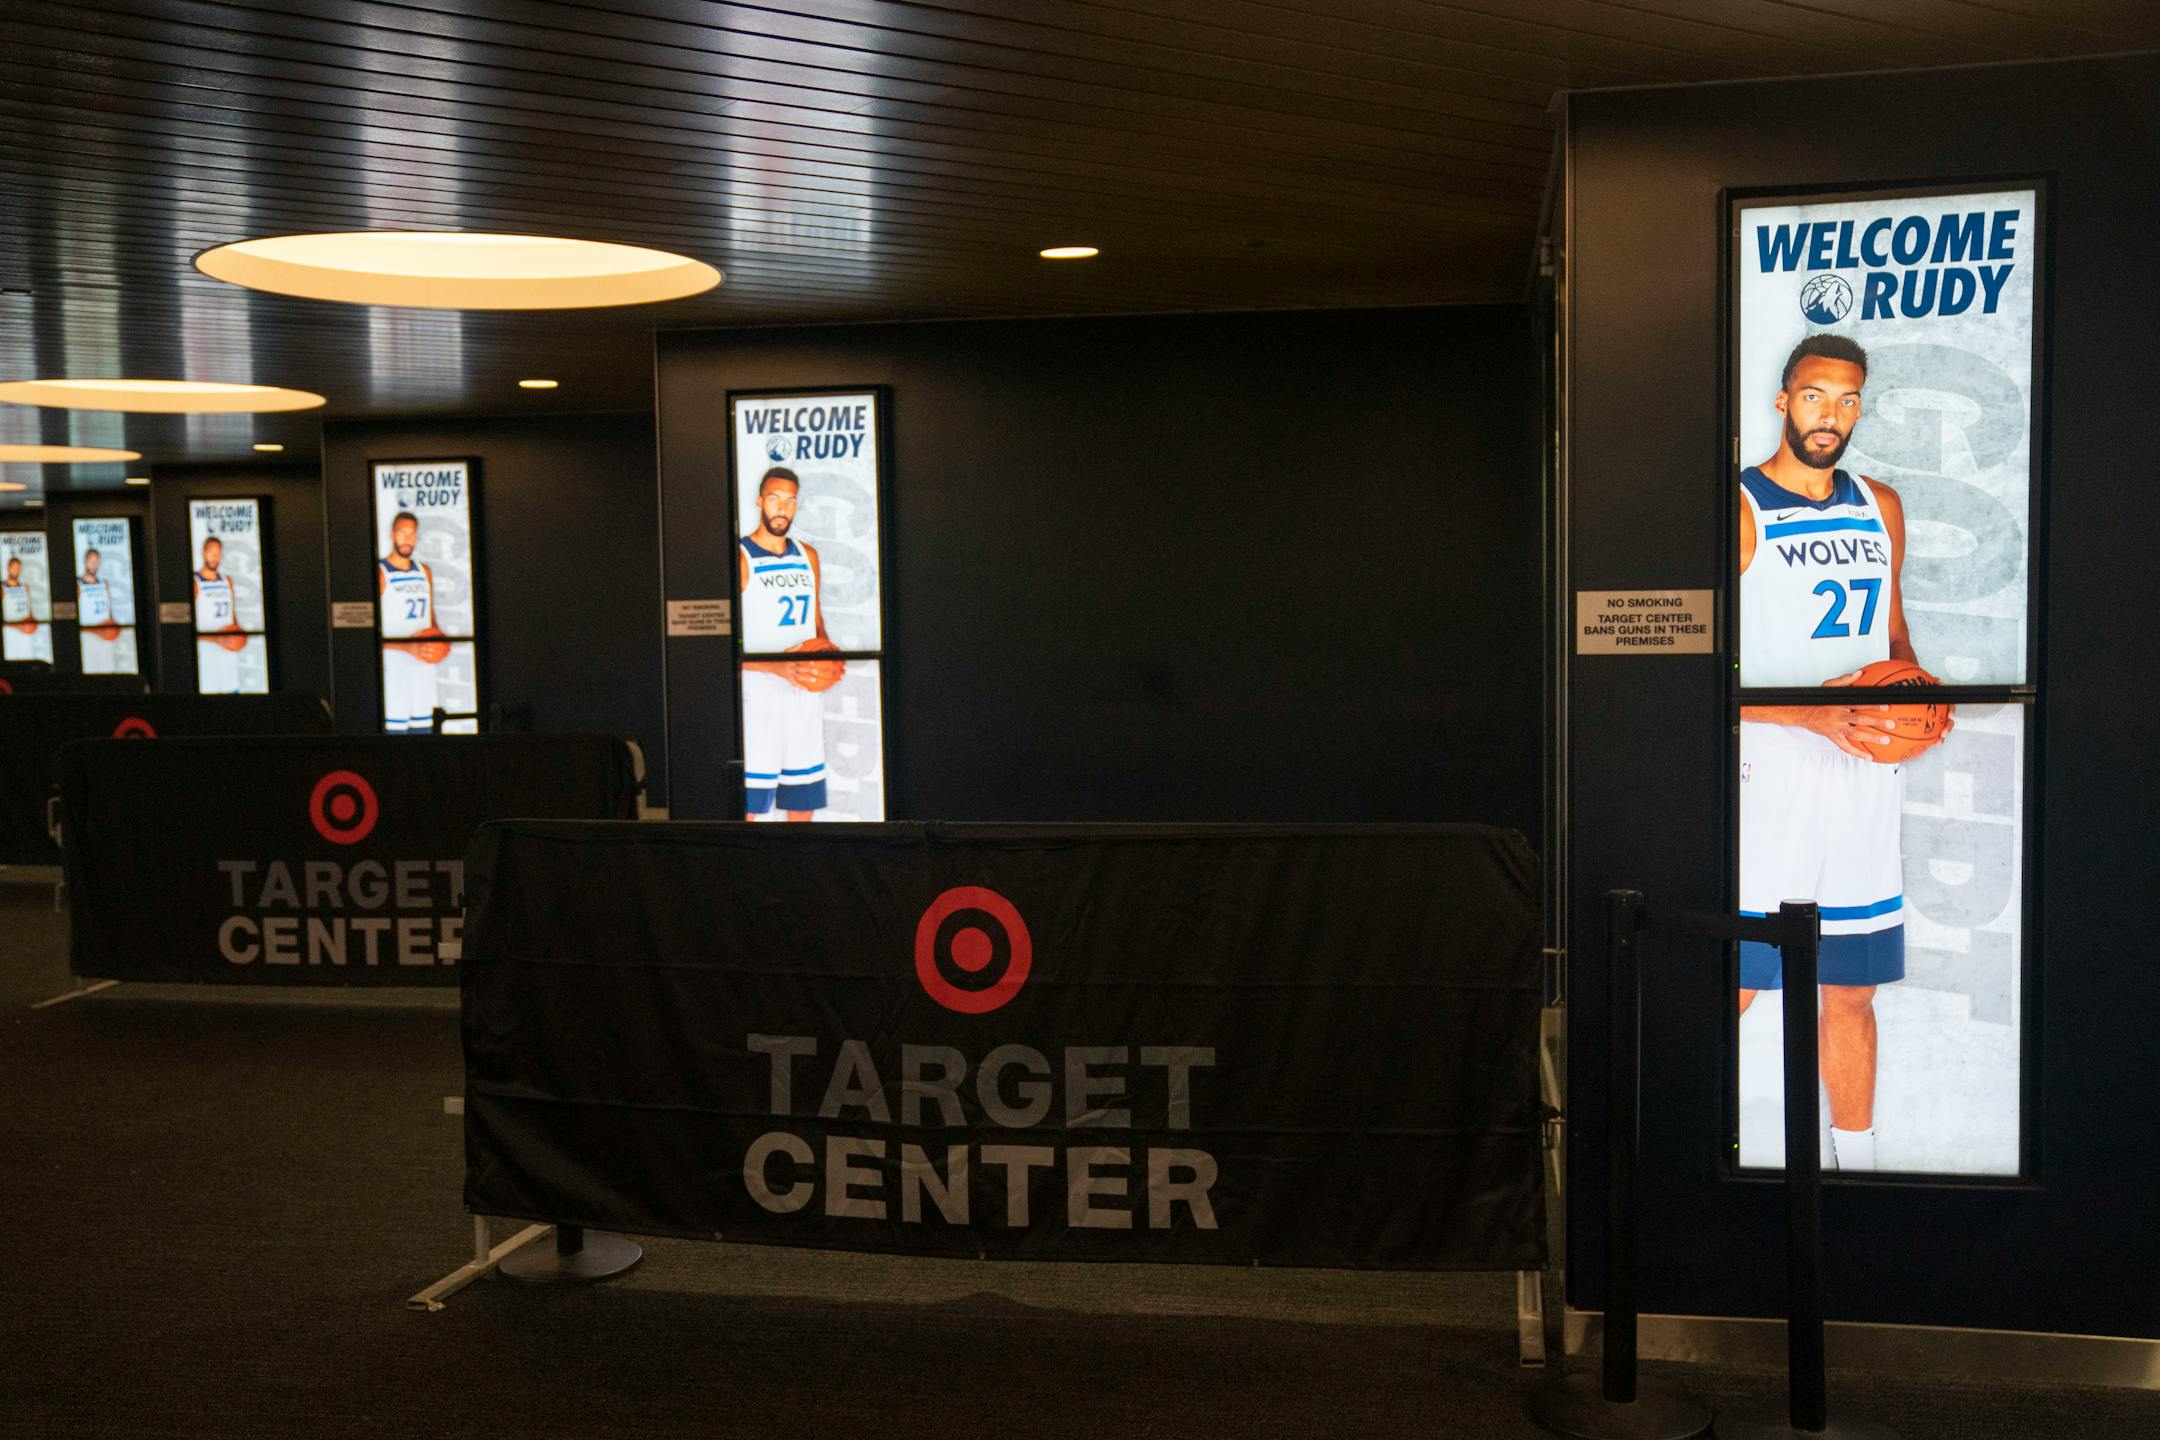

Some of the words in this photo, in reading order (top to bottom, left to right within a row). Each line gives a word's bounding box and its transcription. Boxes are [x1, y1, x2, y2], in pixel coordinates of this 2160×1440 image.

[1757, 209, 2020, 273] WELCOME
[1860, 264, 2015, 320] RUDY
[744, 405, 867, 434] WELCOME
[796, 433, 864, 460] RUDY
[382, 470, 461, 488] WELCOME
[416, 489, 460, 506] RUDY
[1776, 538, 1888, 568] WOLVES
[405, 598, 426, 619] 27
[777, 595, 809, 626] 27
[1607, 598, 1624, 608] NO
[1627, 598, 1682, 607] SMOKING
[1811, 578, 1882, 639] 27
[1584, 626, 1615, 635] BANS
[1619, 625, 1651, 635] GUNS
[1654, 625, 1665, 634] IN
[1669, 624, 1707, 634] THESE
[1598, 614, 1642, 624] TARGET
[1645, 613, 1692, 623] CENTER
[1616, 637, 1675, 646] PREMISES
[217, 860, 464, 909] TARGET
[746, 1033, 1216, 1130] TARGET
[743, 1131, 1219, 1230] CENTER
